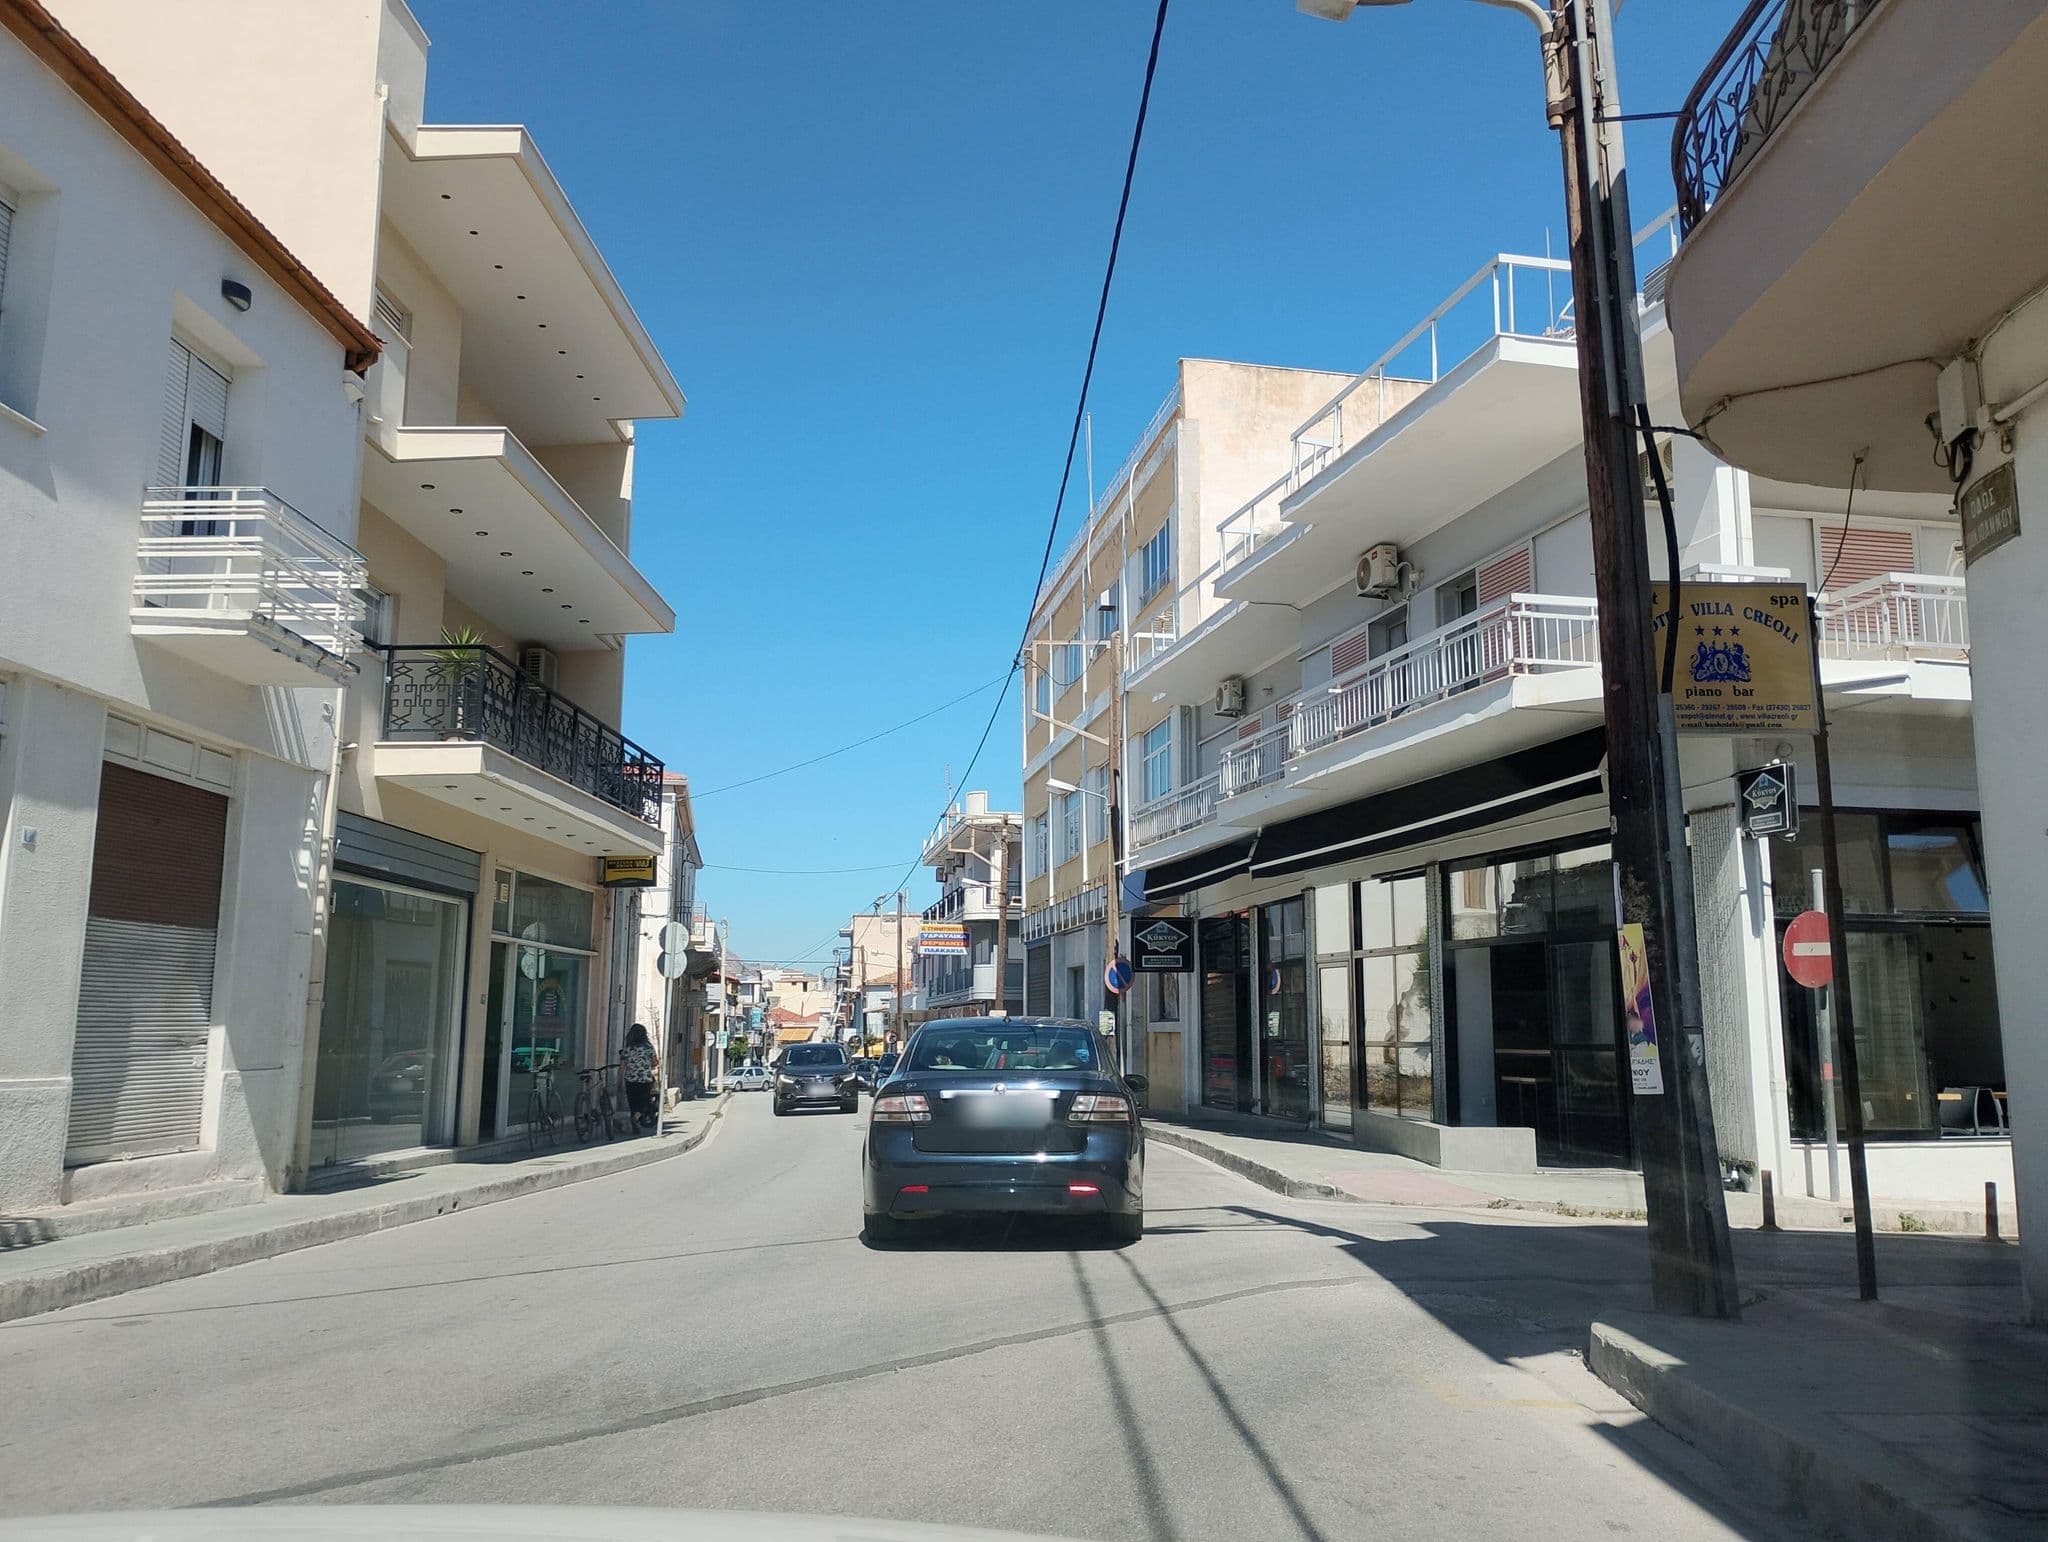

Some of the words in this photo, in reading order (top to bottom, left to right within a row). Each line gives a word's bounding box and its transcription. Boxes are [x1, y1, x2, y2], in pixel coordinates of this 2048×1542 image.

[1769, 594, 1799, 608] spa
[1690, 602, 1734, 616] VILLA
[1743, 607, 1800, 645] CREOLI
[1685, 686, 1722, 699] piano
[1732, 685, 1755, 697] bar
